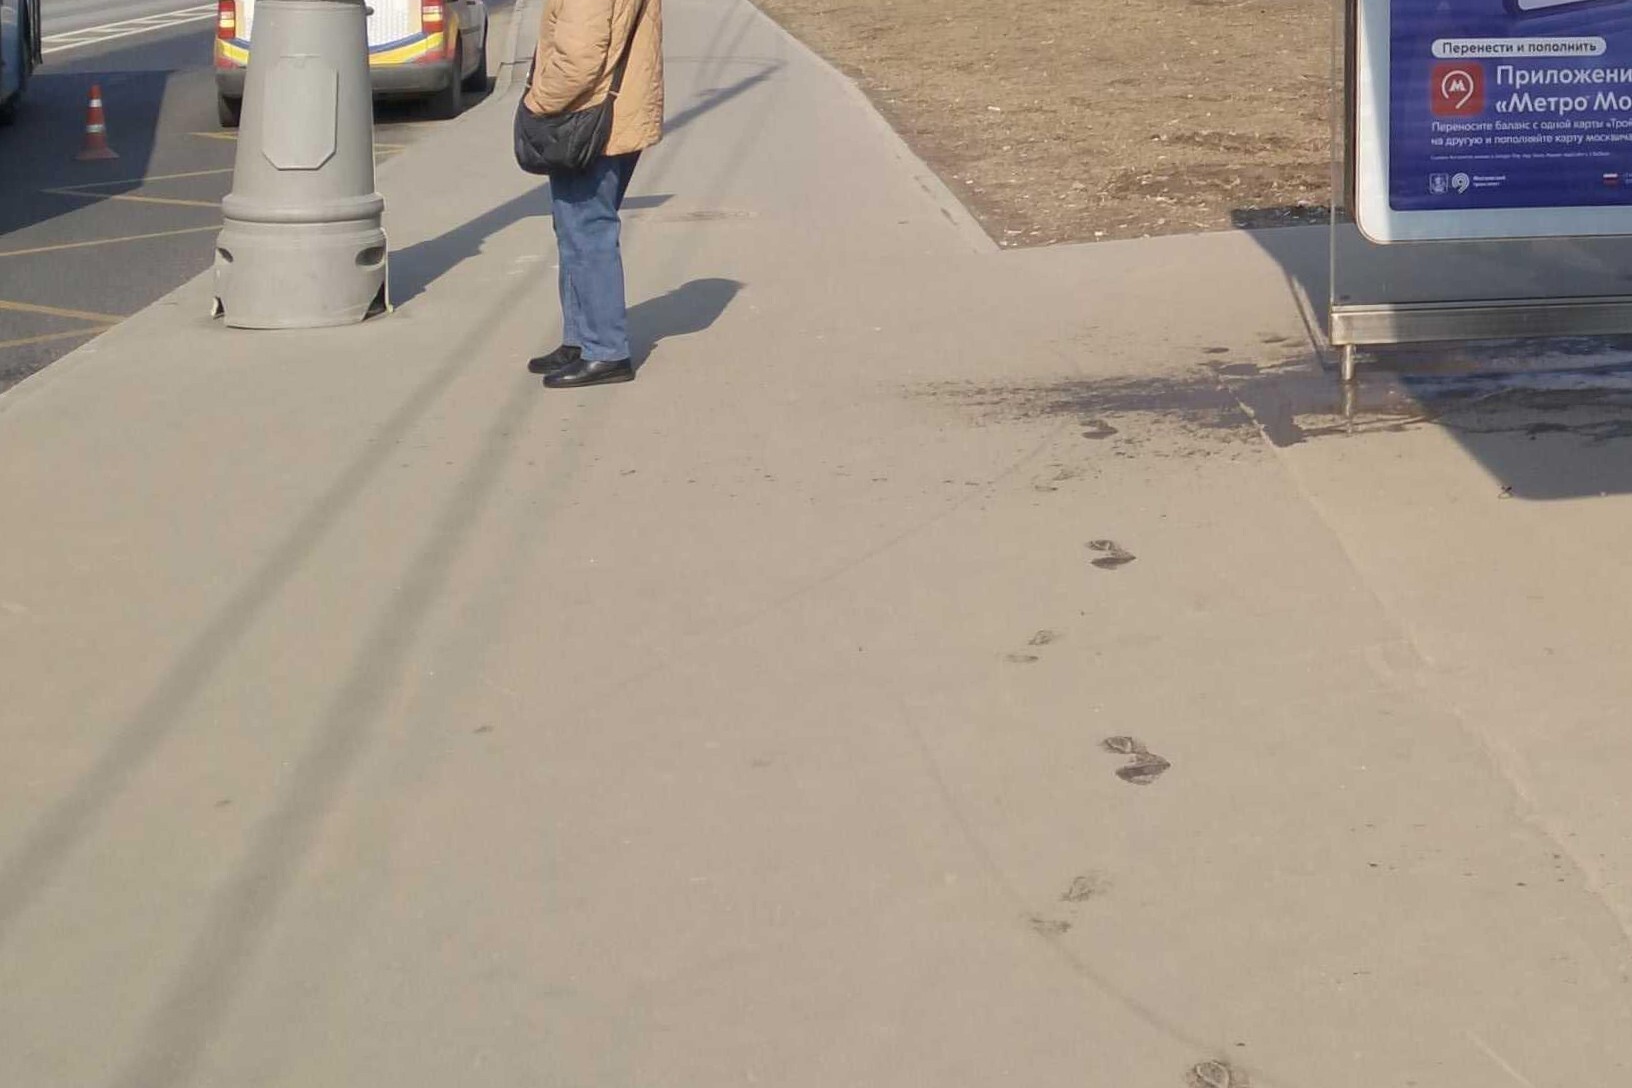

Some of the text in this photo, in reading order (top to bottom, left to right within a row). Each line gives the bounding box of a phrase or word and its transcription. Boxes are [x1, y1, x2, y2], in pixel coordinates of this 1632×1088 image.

[1442, 42, 1597, 55] Перенести и пополнить
[1495, 92, 1588, 116] «Метро
[1431, 121, 1493, 133] Переносите
[1495, 119, 1531, 131] баланс
[1532, 121, 1538, 130] с
[1540, 119, 1571, 131] одной
[1573, 119, 1604, 131] карты
[1430, 137, 1444, 146] на
[1445, 135, 1483, 147] другую
[1485, 136, 1492, 144] и
[1555, 133, 1583, 144] карту
